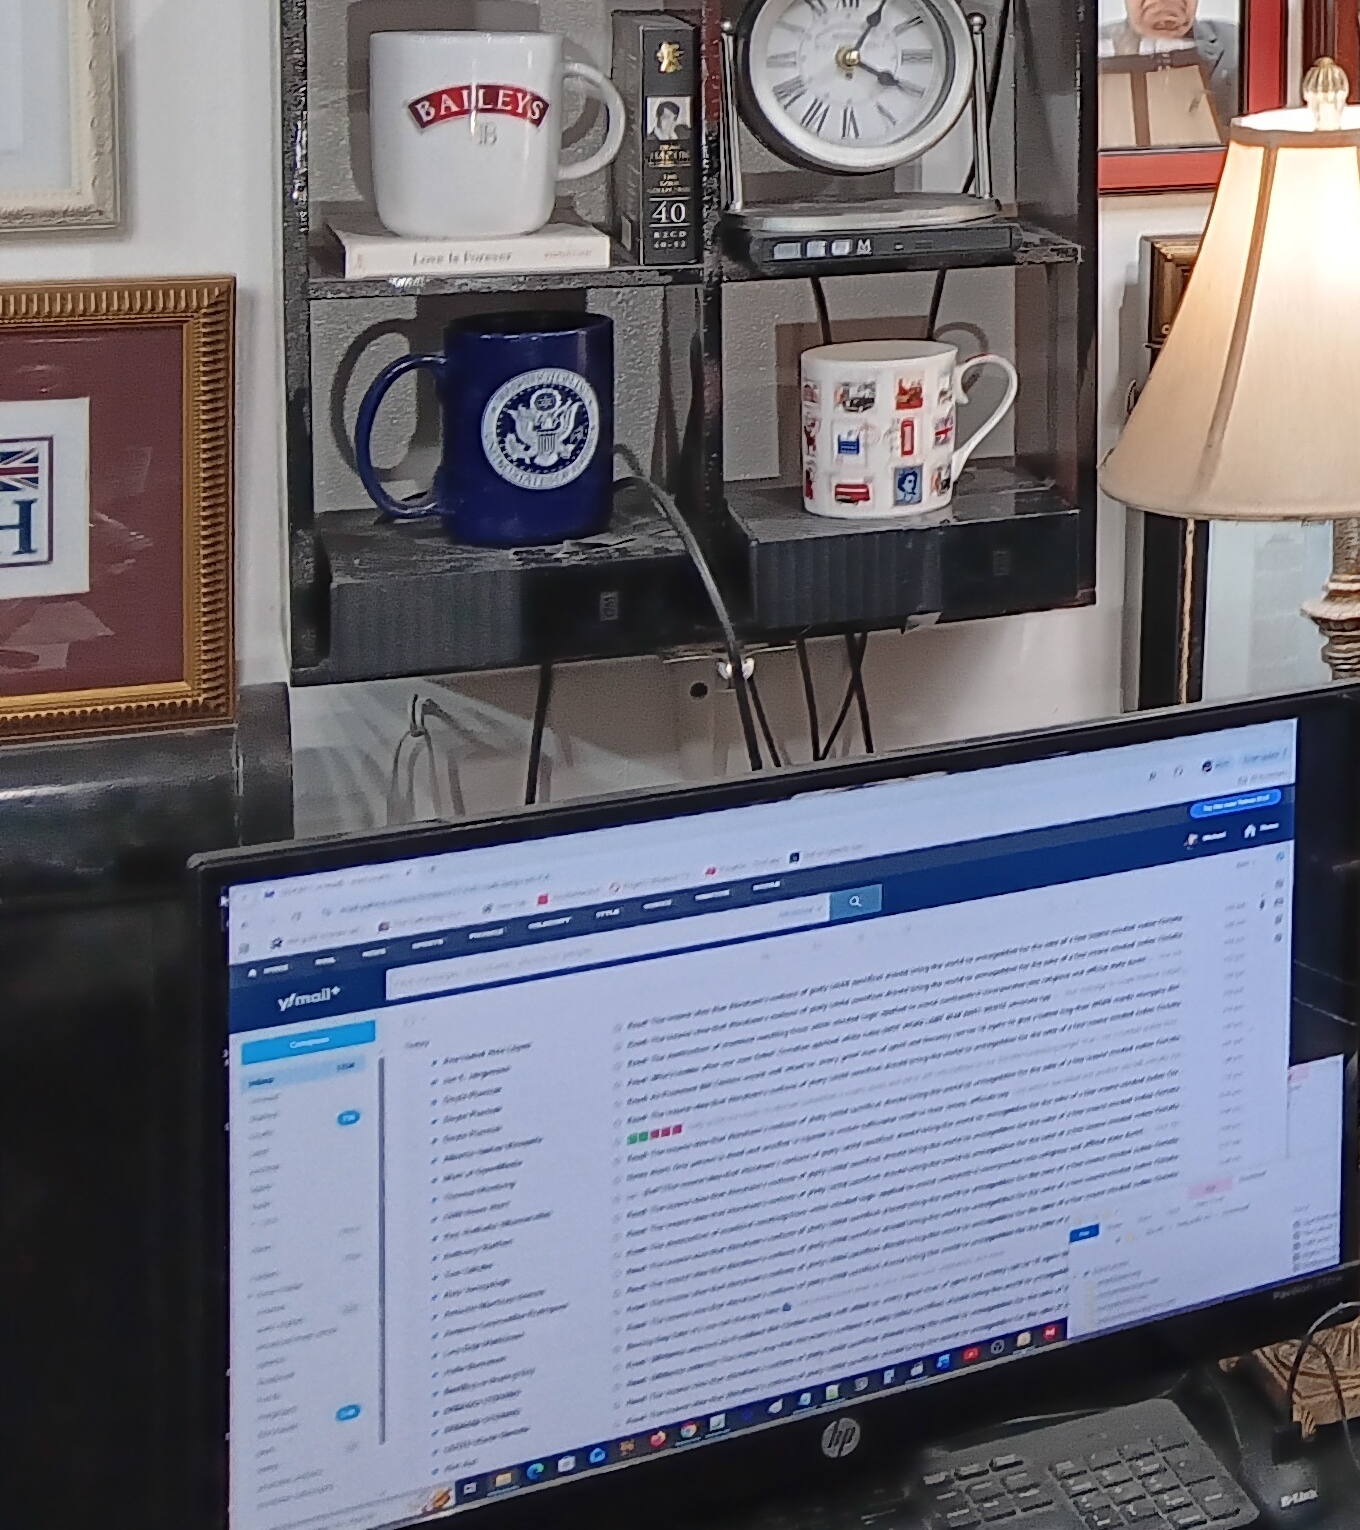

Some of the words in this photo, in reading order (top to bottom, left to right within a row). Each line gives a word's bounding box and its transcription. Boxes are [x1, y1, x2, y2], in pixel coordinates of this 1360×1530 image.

[414, 88, 544, 123] BAILEYS
[651, 199, 688, 224] 40
[827, 1420, 856, 1457] hp
